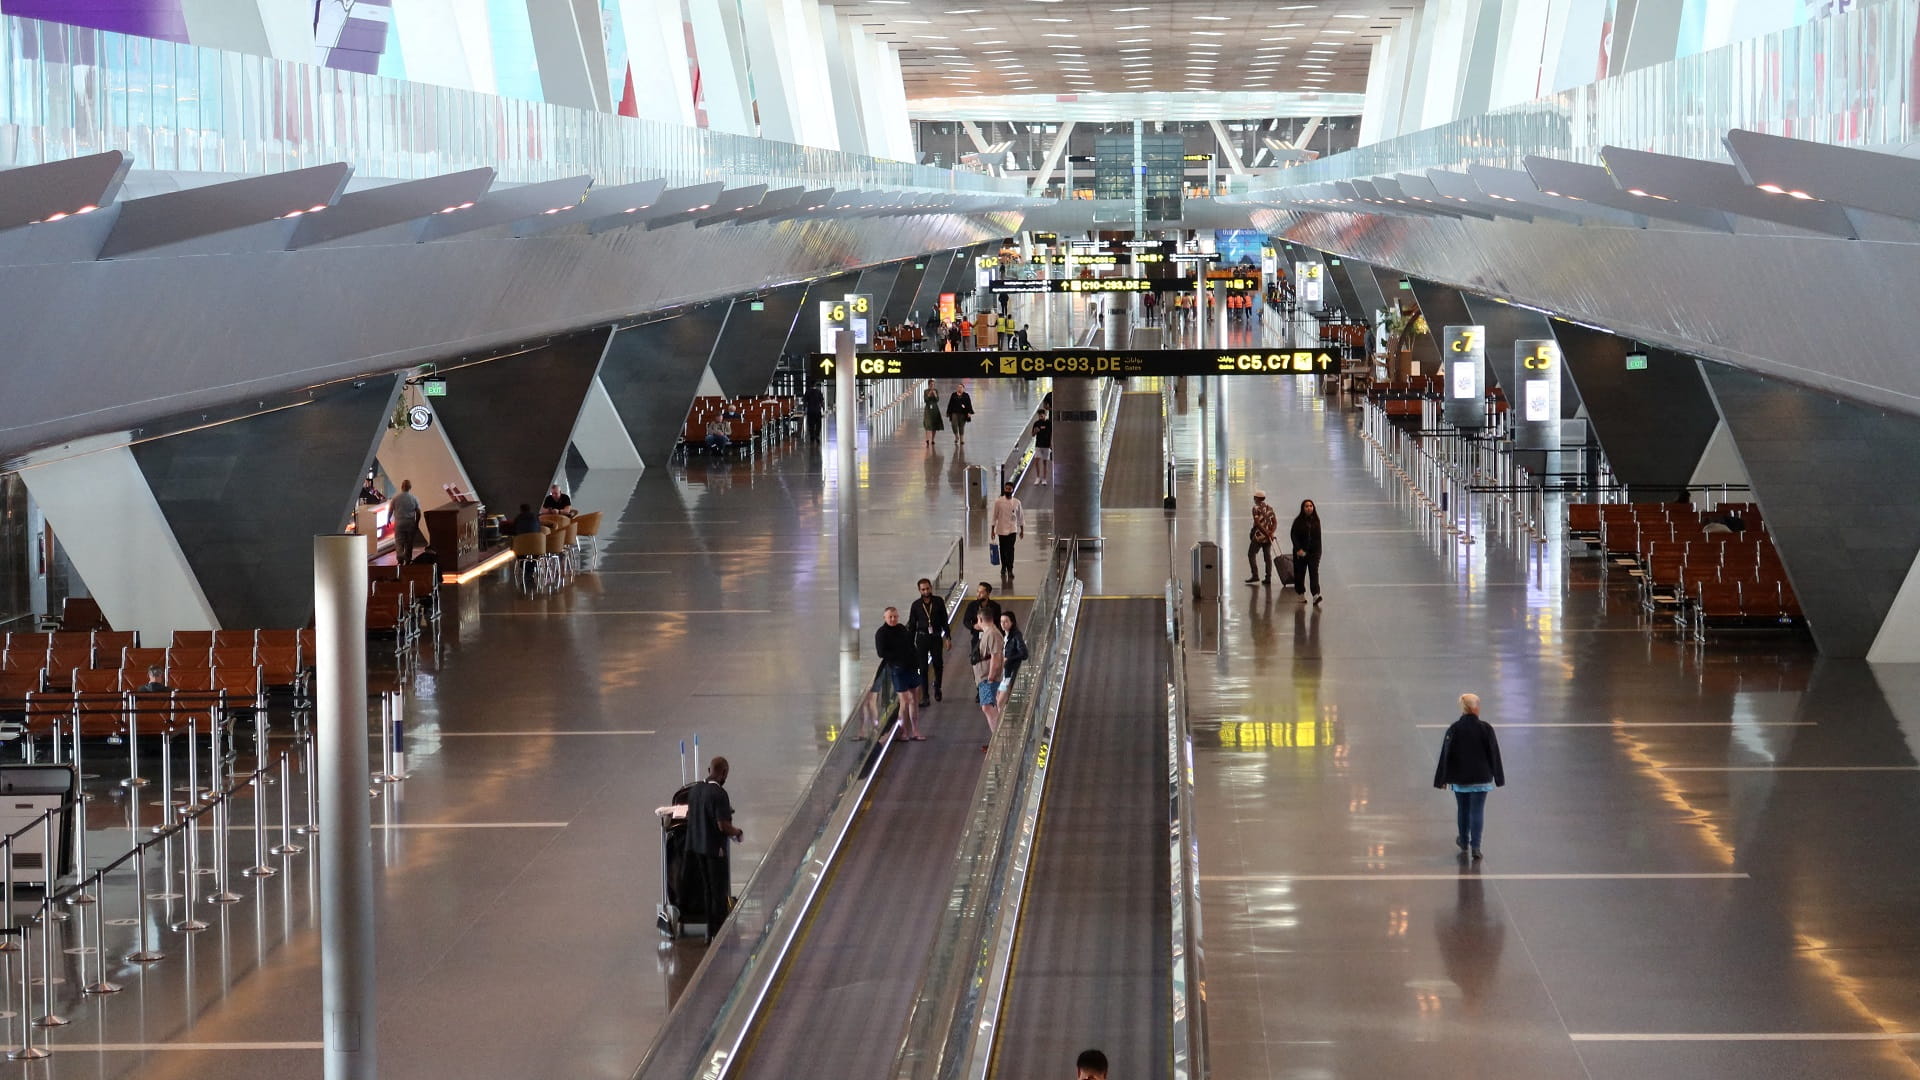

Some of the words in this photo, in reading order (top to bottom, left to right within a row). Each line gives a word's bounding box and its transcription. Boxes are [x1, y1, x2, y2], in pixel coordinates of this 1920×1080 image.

[860, 358, 885, 374] C6
[1020, 357, 1121, 375] C8-C93,DE
[1237, 354, 1291, 371] C5,C7
